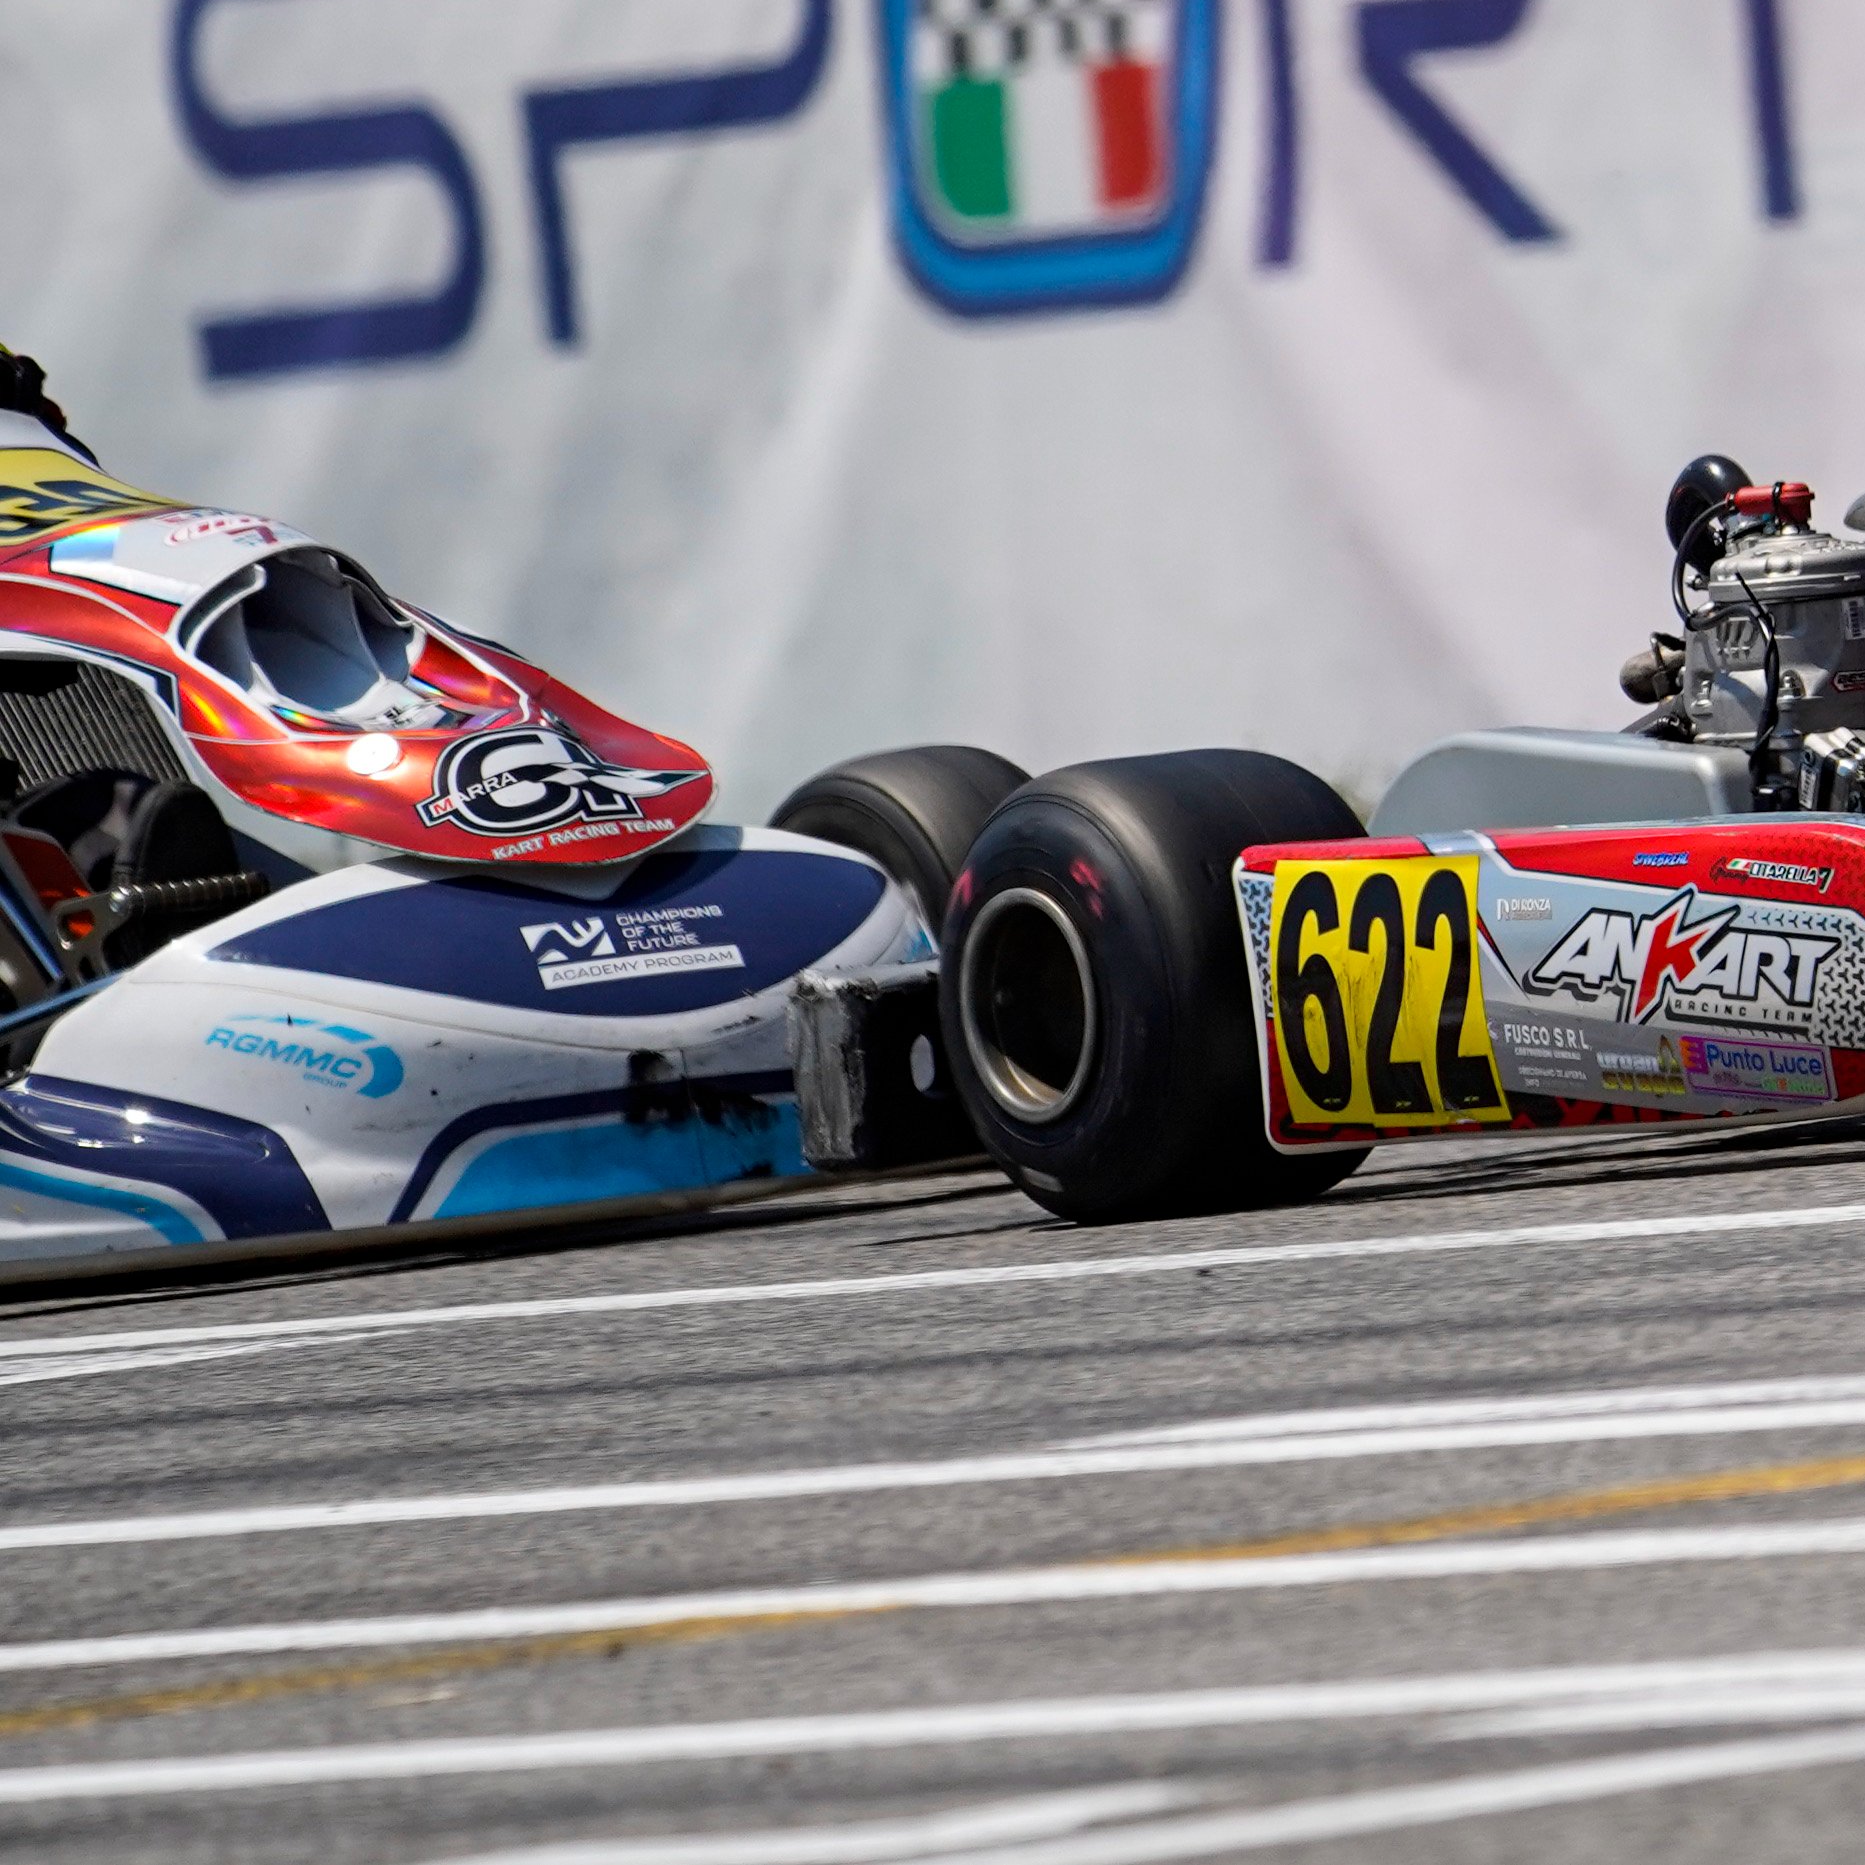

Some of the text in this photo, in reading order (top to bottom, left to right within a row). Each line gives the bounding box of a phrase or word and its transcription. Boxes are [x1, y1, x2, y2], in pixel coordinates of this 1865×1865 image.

[432, 771, 519, 817] MARRA
[491, 817, 676, 860] KART RACING TEAM
[1750, 861, 1817, 884] CITARELLA
[615, 904, 724, 927] CHAMPIONS
[621, 920, 685, 939] OF THE
[626, 933, 701, 953] FUTURE
[1530, 885, 1842, 1025] ANKART
[550, 949, 735, 985] ACADEMY PROGRAM
[1277, 869, 1501, 1114] 622
[1674, 999, 1813, 1023] RACING TEAM
[1503, 1024, 1550, 1045] FUSCO
[205, 1028, 362, 1078] RGMMC
[1706, 1043, 1823, 1076] Punto Luce
